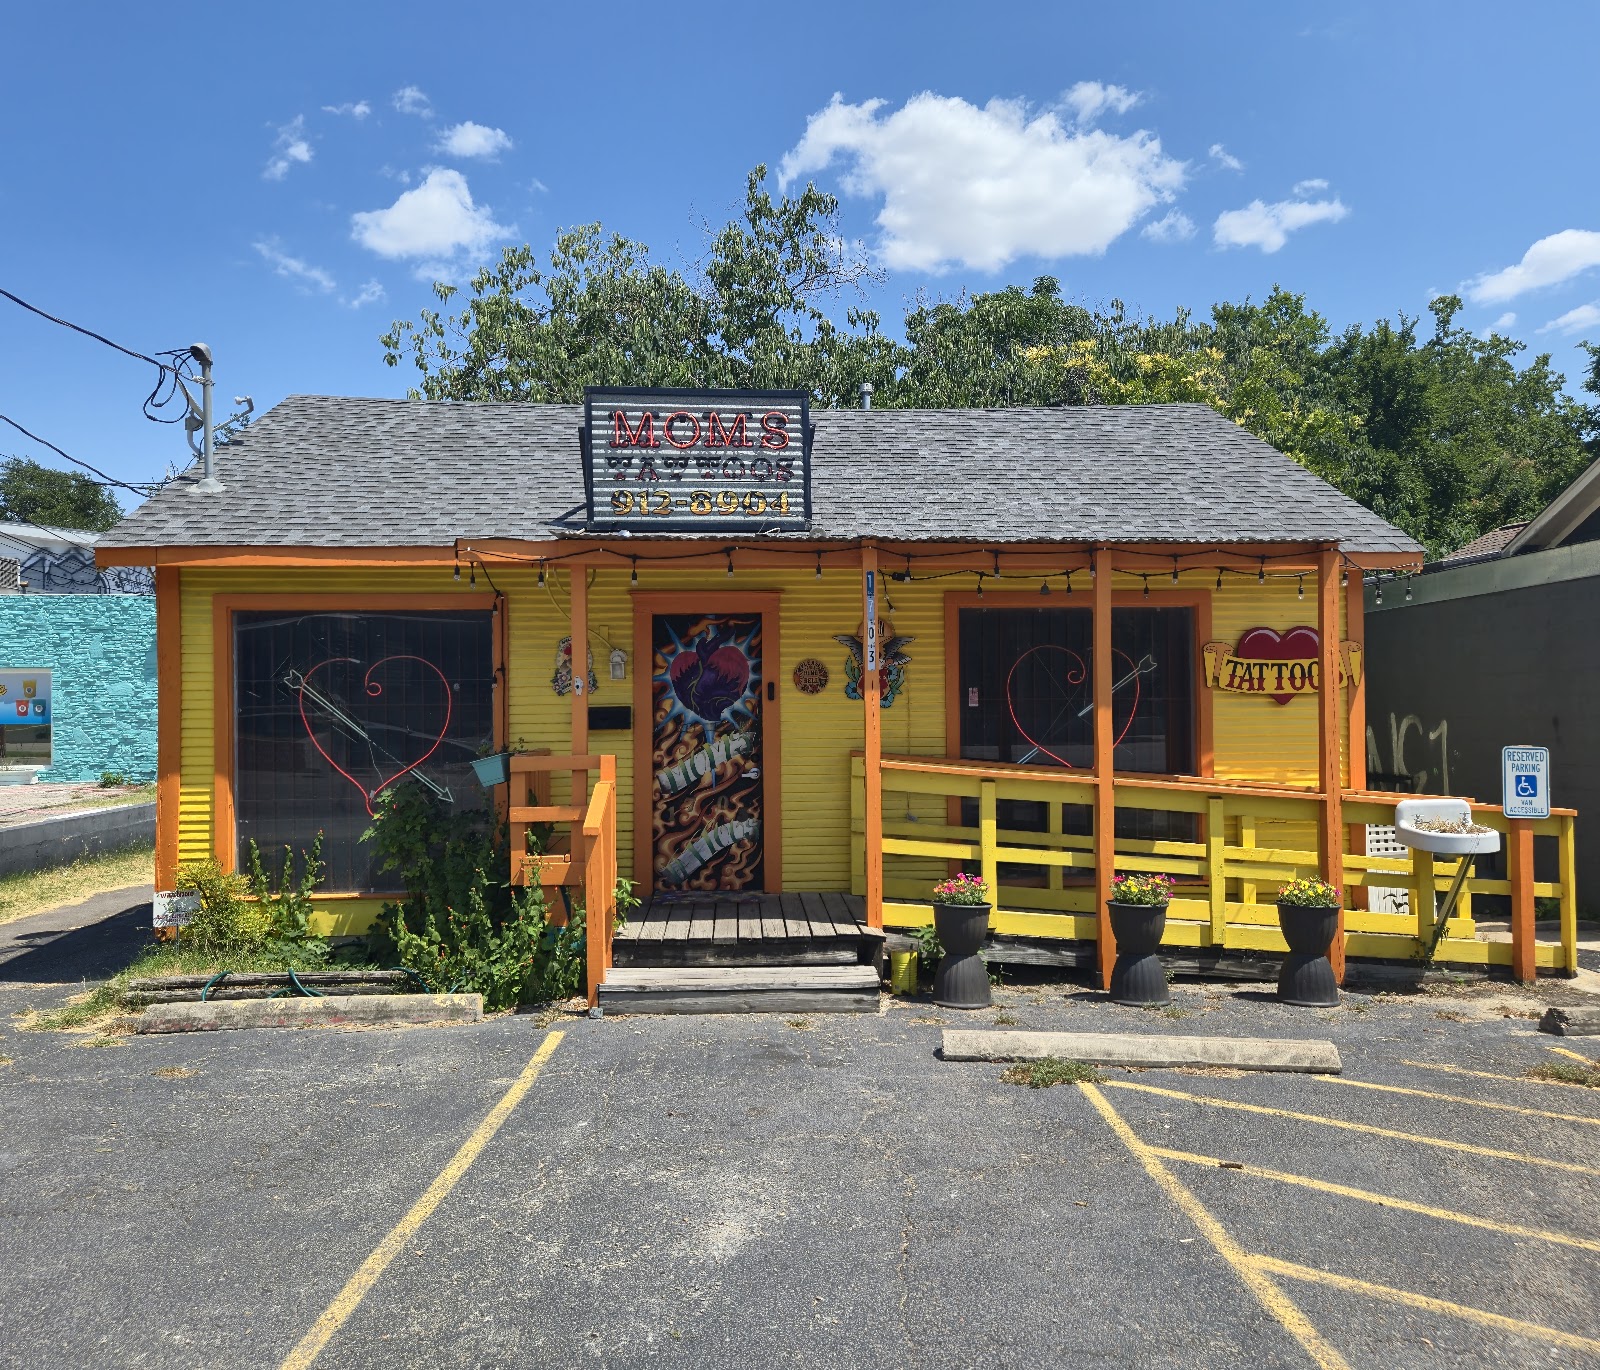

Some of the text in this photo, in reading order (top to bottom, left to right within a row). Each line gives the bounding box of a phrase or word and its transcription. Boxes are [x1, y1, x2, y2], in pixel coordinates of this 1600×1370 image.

[608, 410, 790, 450] MOMS
[605, 456, 795, 481] TATTOOS
[610, 489, 791, 516] 912-8904
[1225, 659, 1343, 692] TATTOO
[1507, 751, 1544, 762] RESERVED
[1511, 763, 1541, 773] PARKING
[1509, 806, 1545, 814] ACCESSIBLE
